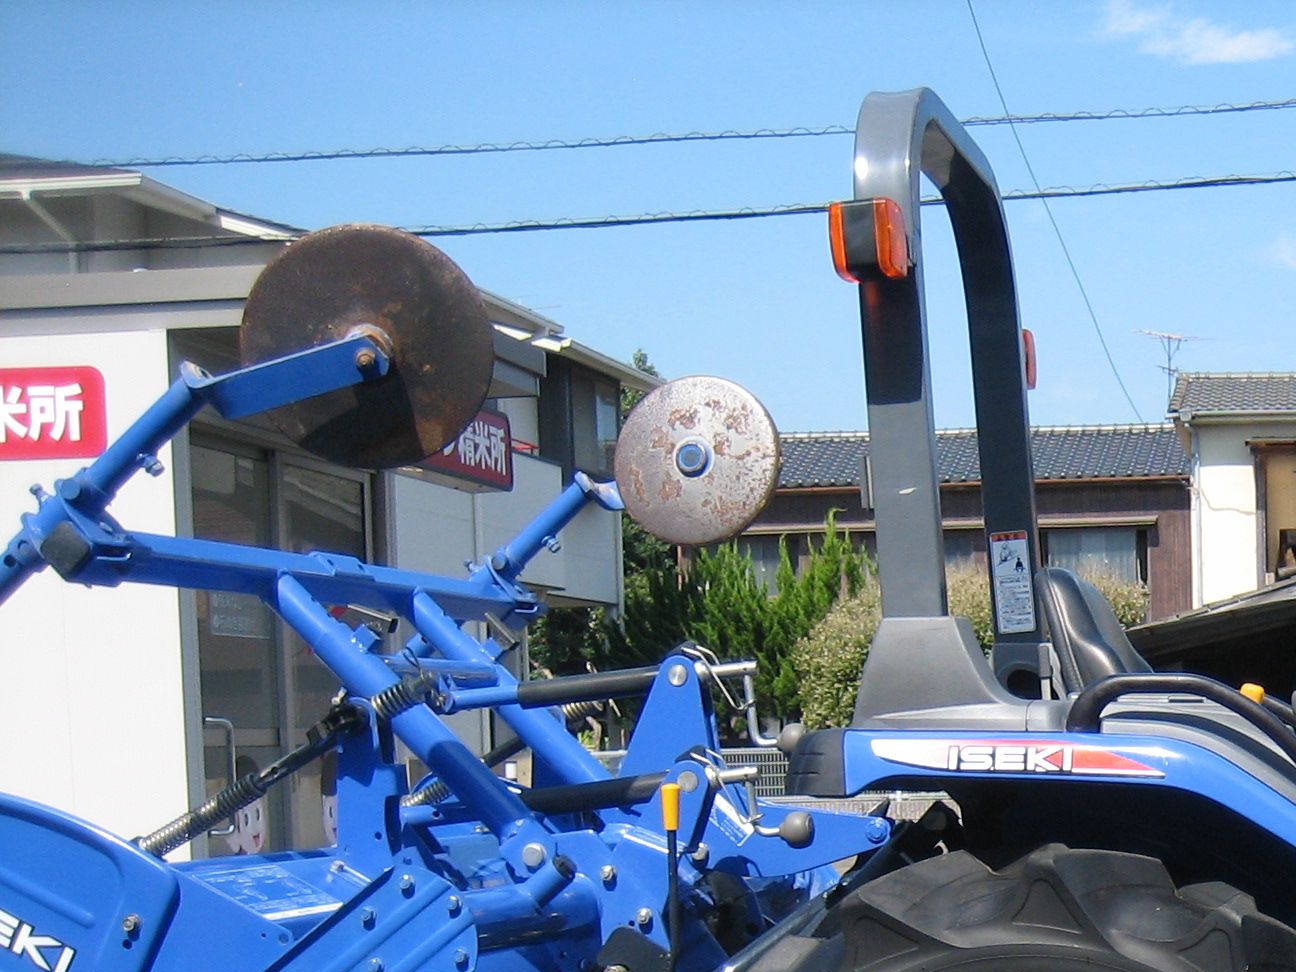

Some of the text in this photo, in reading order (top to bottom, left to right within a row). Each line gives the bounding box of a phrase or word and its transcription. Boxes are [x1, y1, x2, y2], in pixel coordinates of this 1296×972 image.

[443, 421, 506, 476] 精米所
[947, 745, 1073, 773] ISEKI
